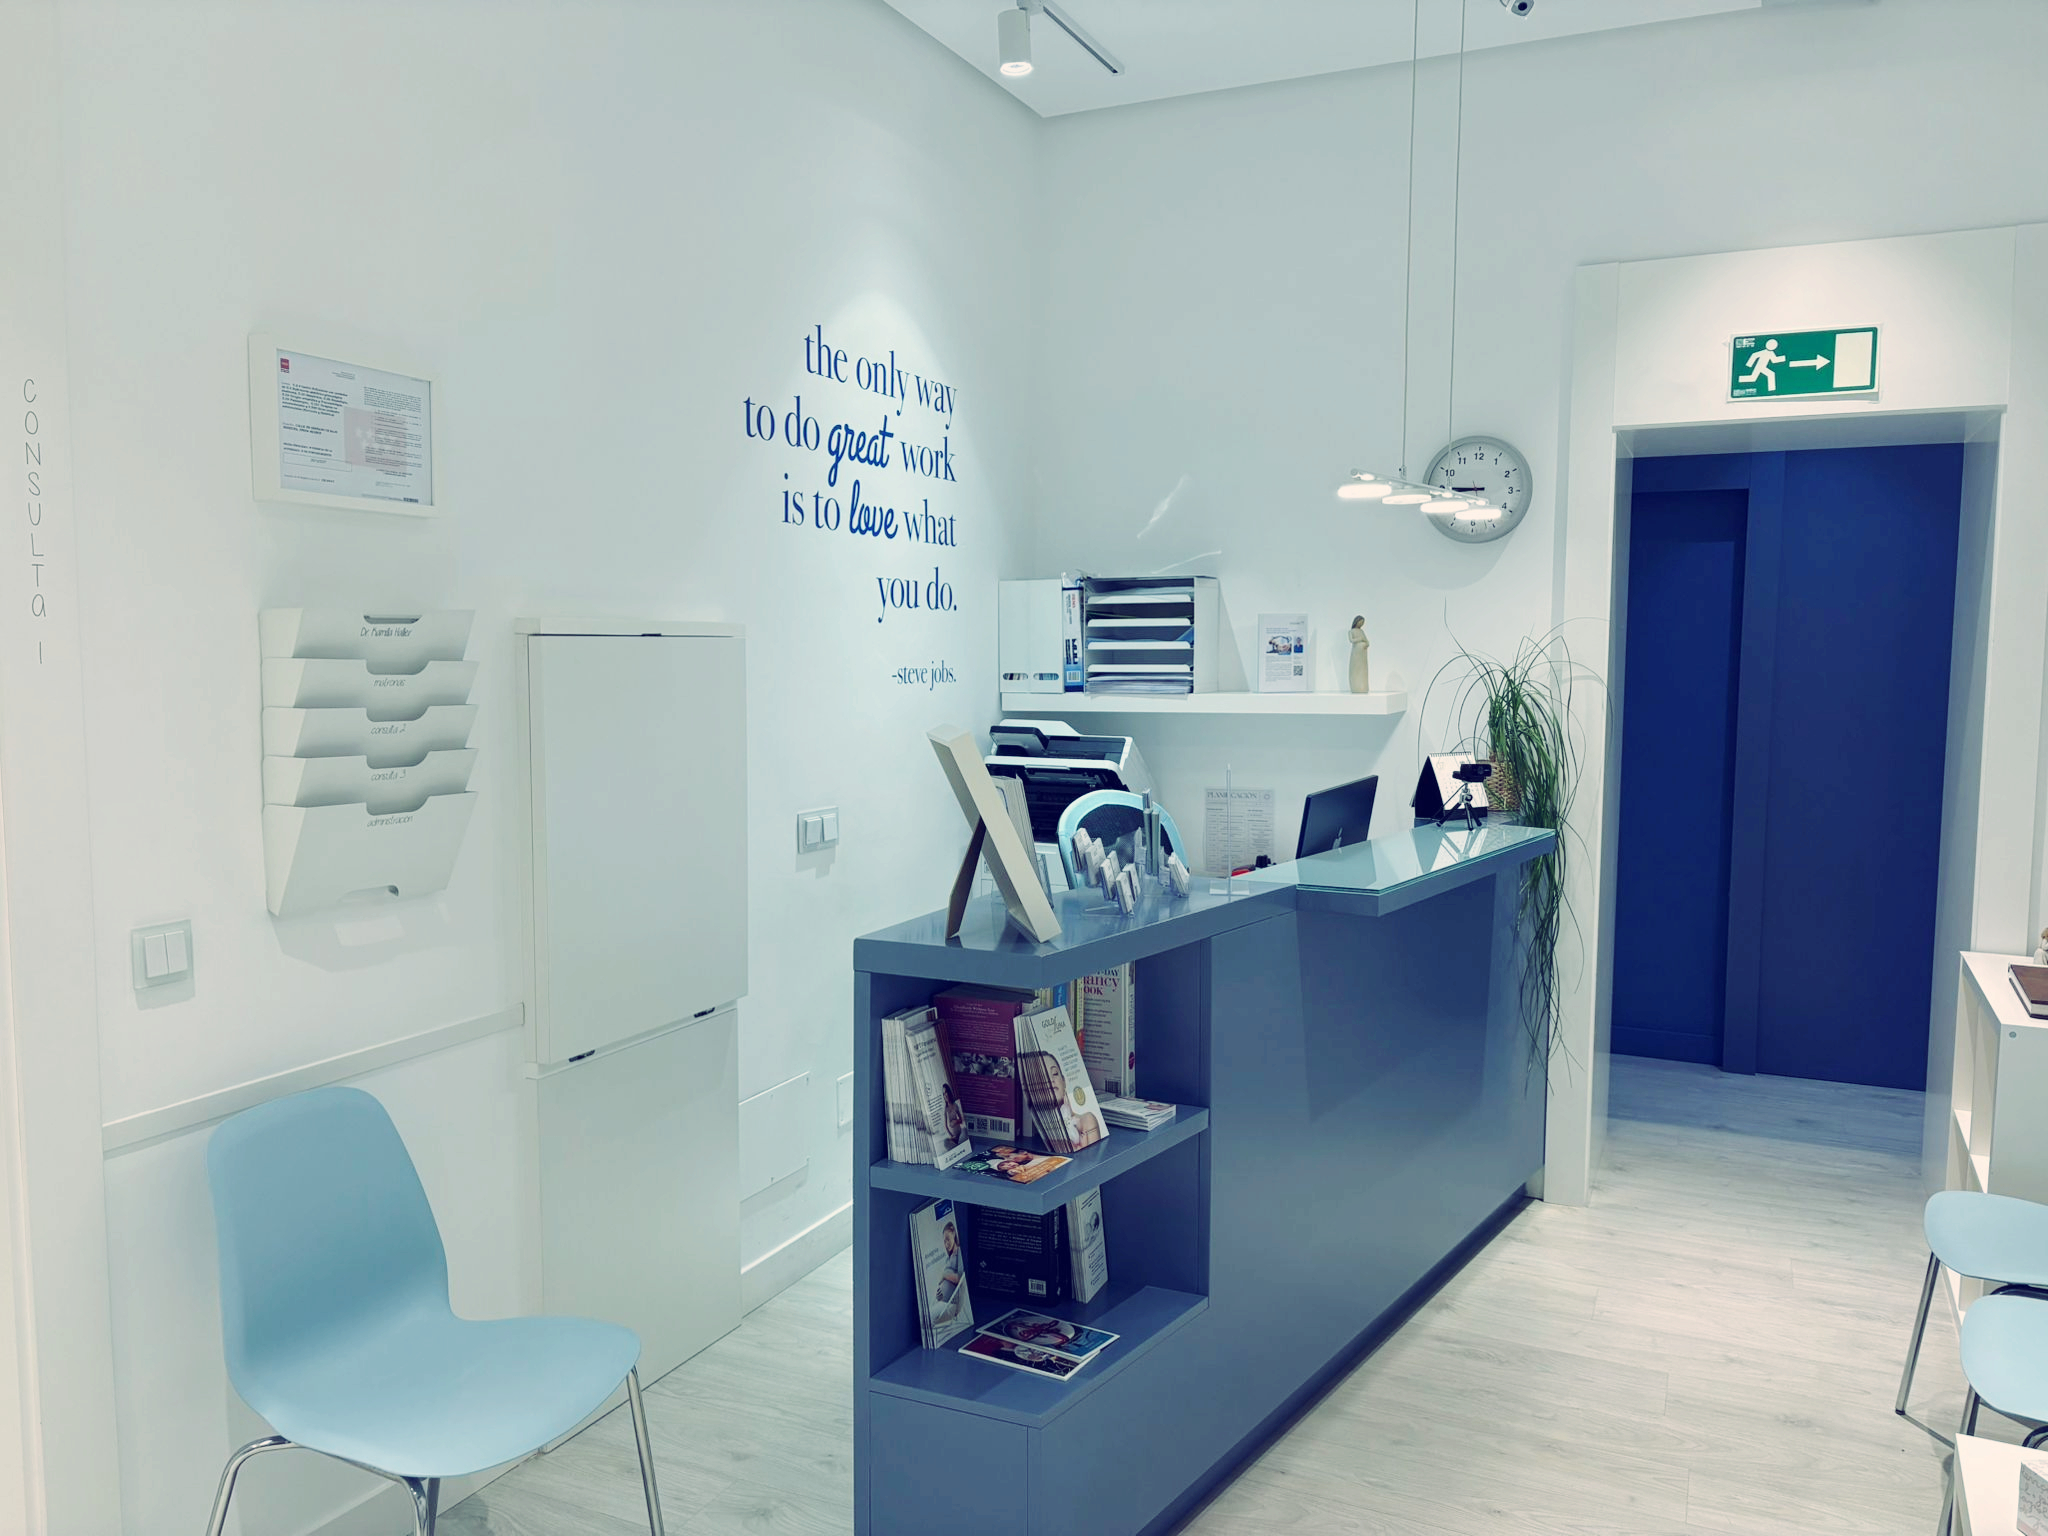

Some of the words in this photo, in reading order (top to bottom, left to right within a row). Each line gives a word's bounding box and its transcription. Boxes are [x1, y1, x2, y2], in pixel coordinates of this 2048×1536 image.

[803, 324, 848, 384] the
[856, 350, 909, 417] only
[915, 373, 957, 431] way
[743, 396, 776, 441] to
[784, 395, 821, 451] do
[827, 414, 895, 488] great
[900, 436, 957, 482] work
[1474, 452, 1485, 461] 12
[1445, 469, 1455, 477] 10
[1504, 470, 1510, 478] 2
[1508, 487, 1514, 495] 3
[781, 473, 805, 526] is
[812, 490, 841, 531] to
[849, 480, 899, 540] love
[902, 498, 957, 548] what
[1501, 502, 1508, 510] 4
[876, 577, 920, 624] you
[926, 566, 958, 612] do.
[892, 664, 928, 684] -steve
[929, 661, 957, 690] jobs.
[370, 725, 398, 735] consulta
[400, 723, 406, 733] 2
[371, 770, 398, 781] consulta
[400, 769, 406, 779] 3
